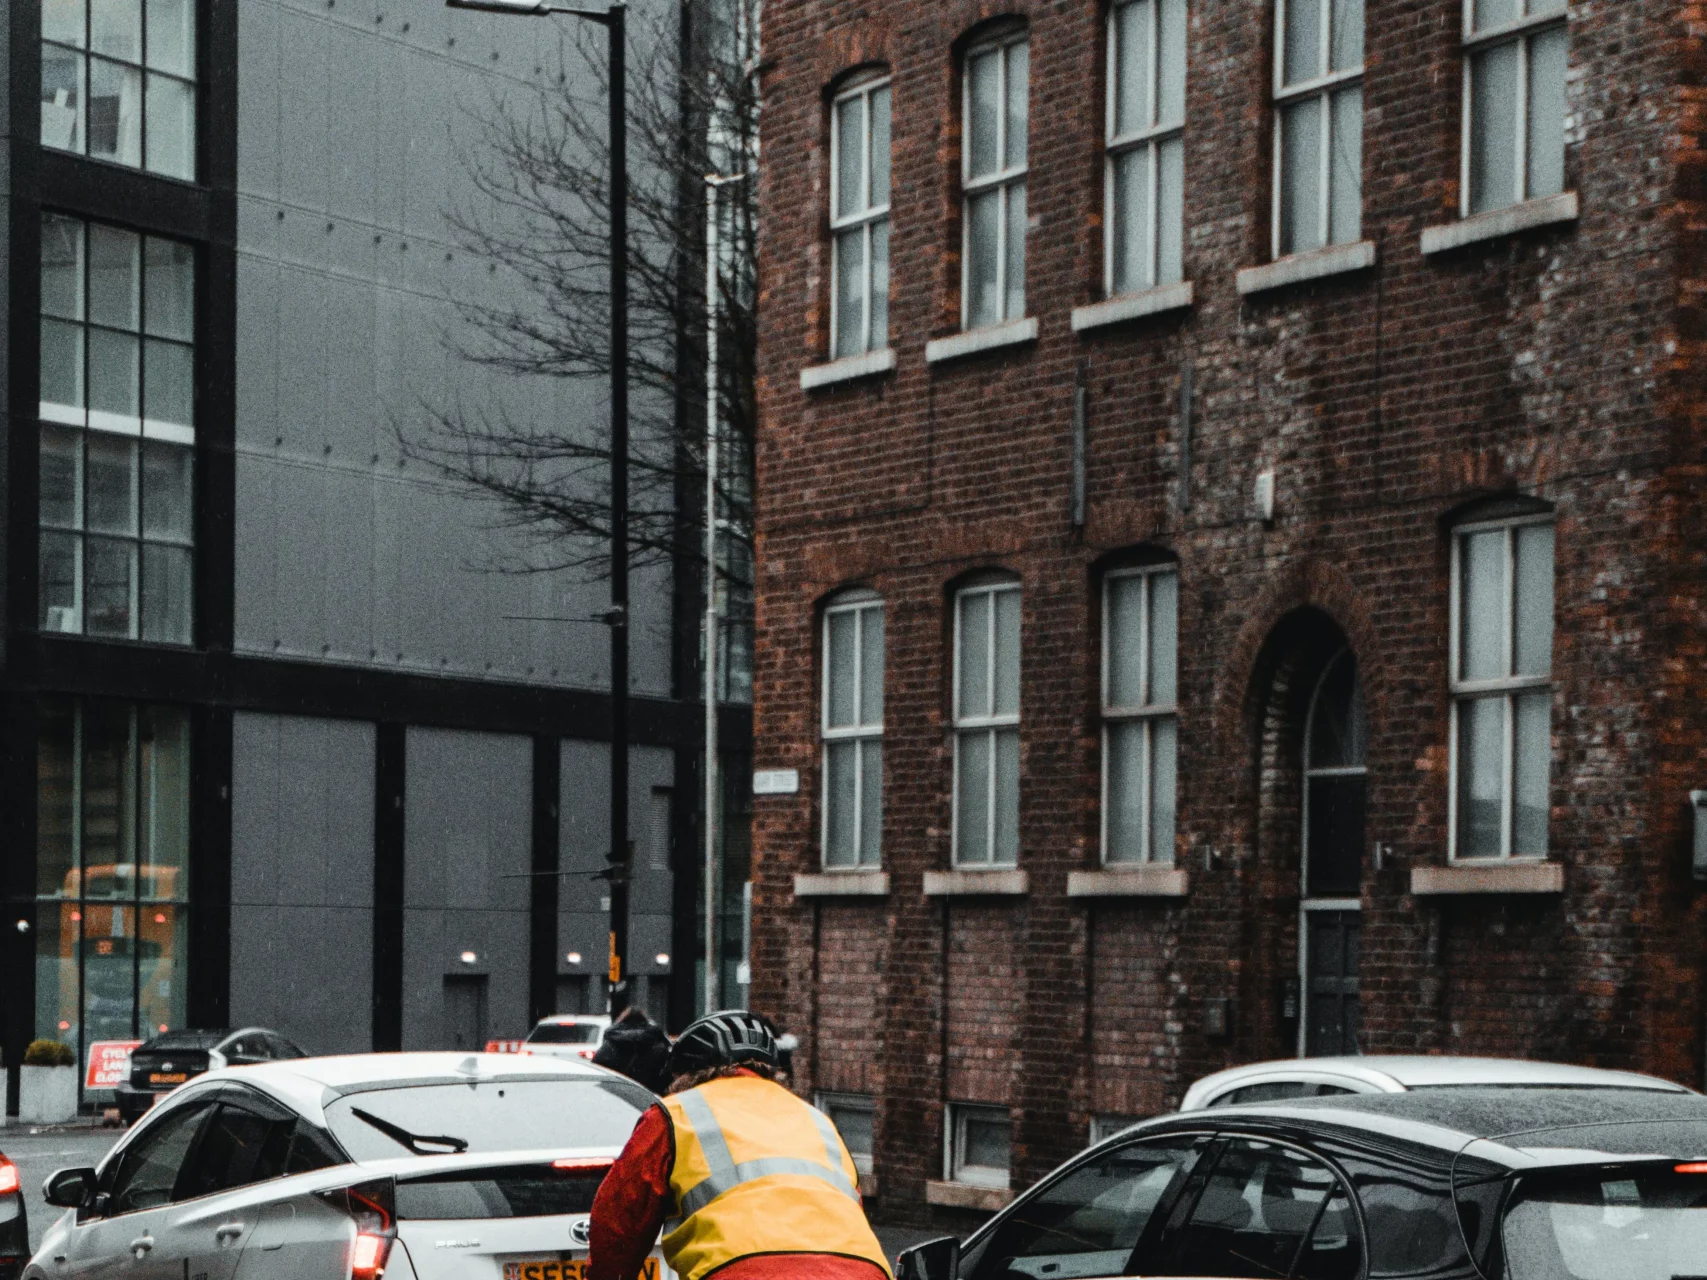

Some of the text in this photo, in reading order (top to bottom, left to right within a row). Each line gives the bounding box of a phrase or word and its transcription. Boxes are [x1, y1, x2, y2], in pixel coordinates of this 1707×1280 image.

[103, 1060, 123, 1071] LAN
[95, 1071, 121, 1083] CLOS
[434, 1238, 481, 1249] PRIUS
